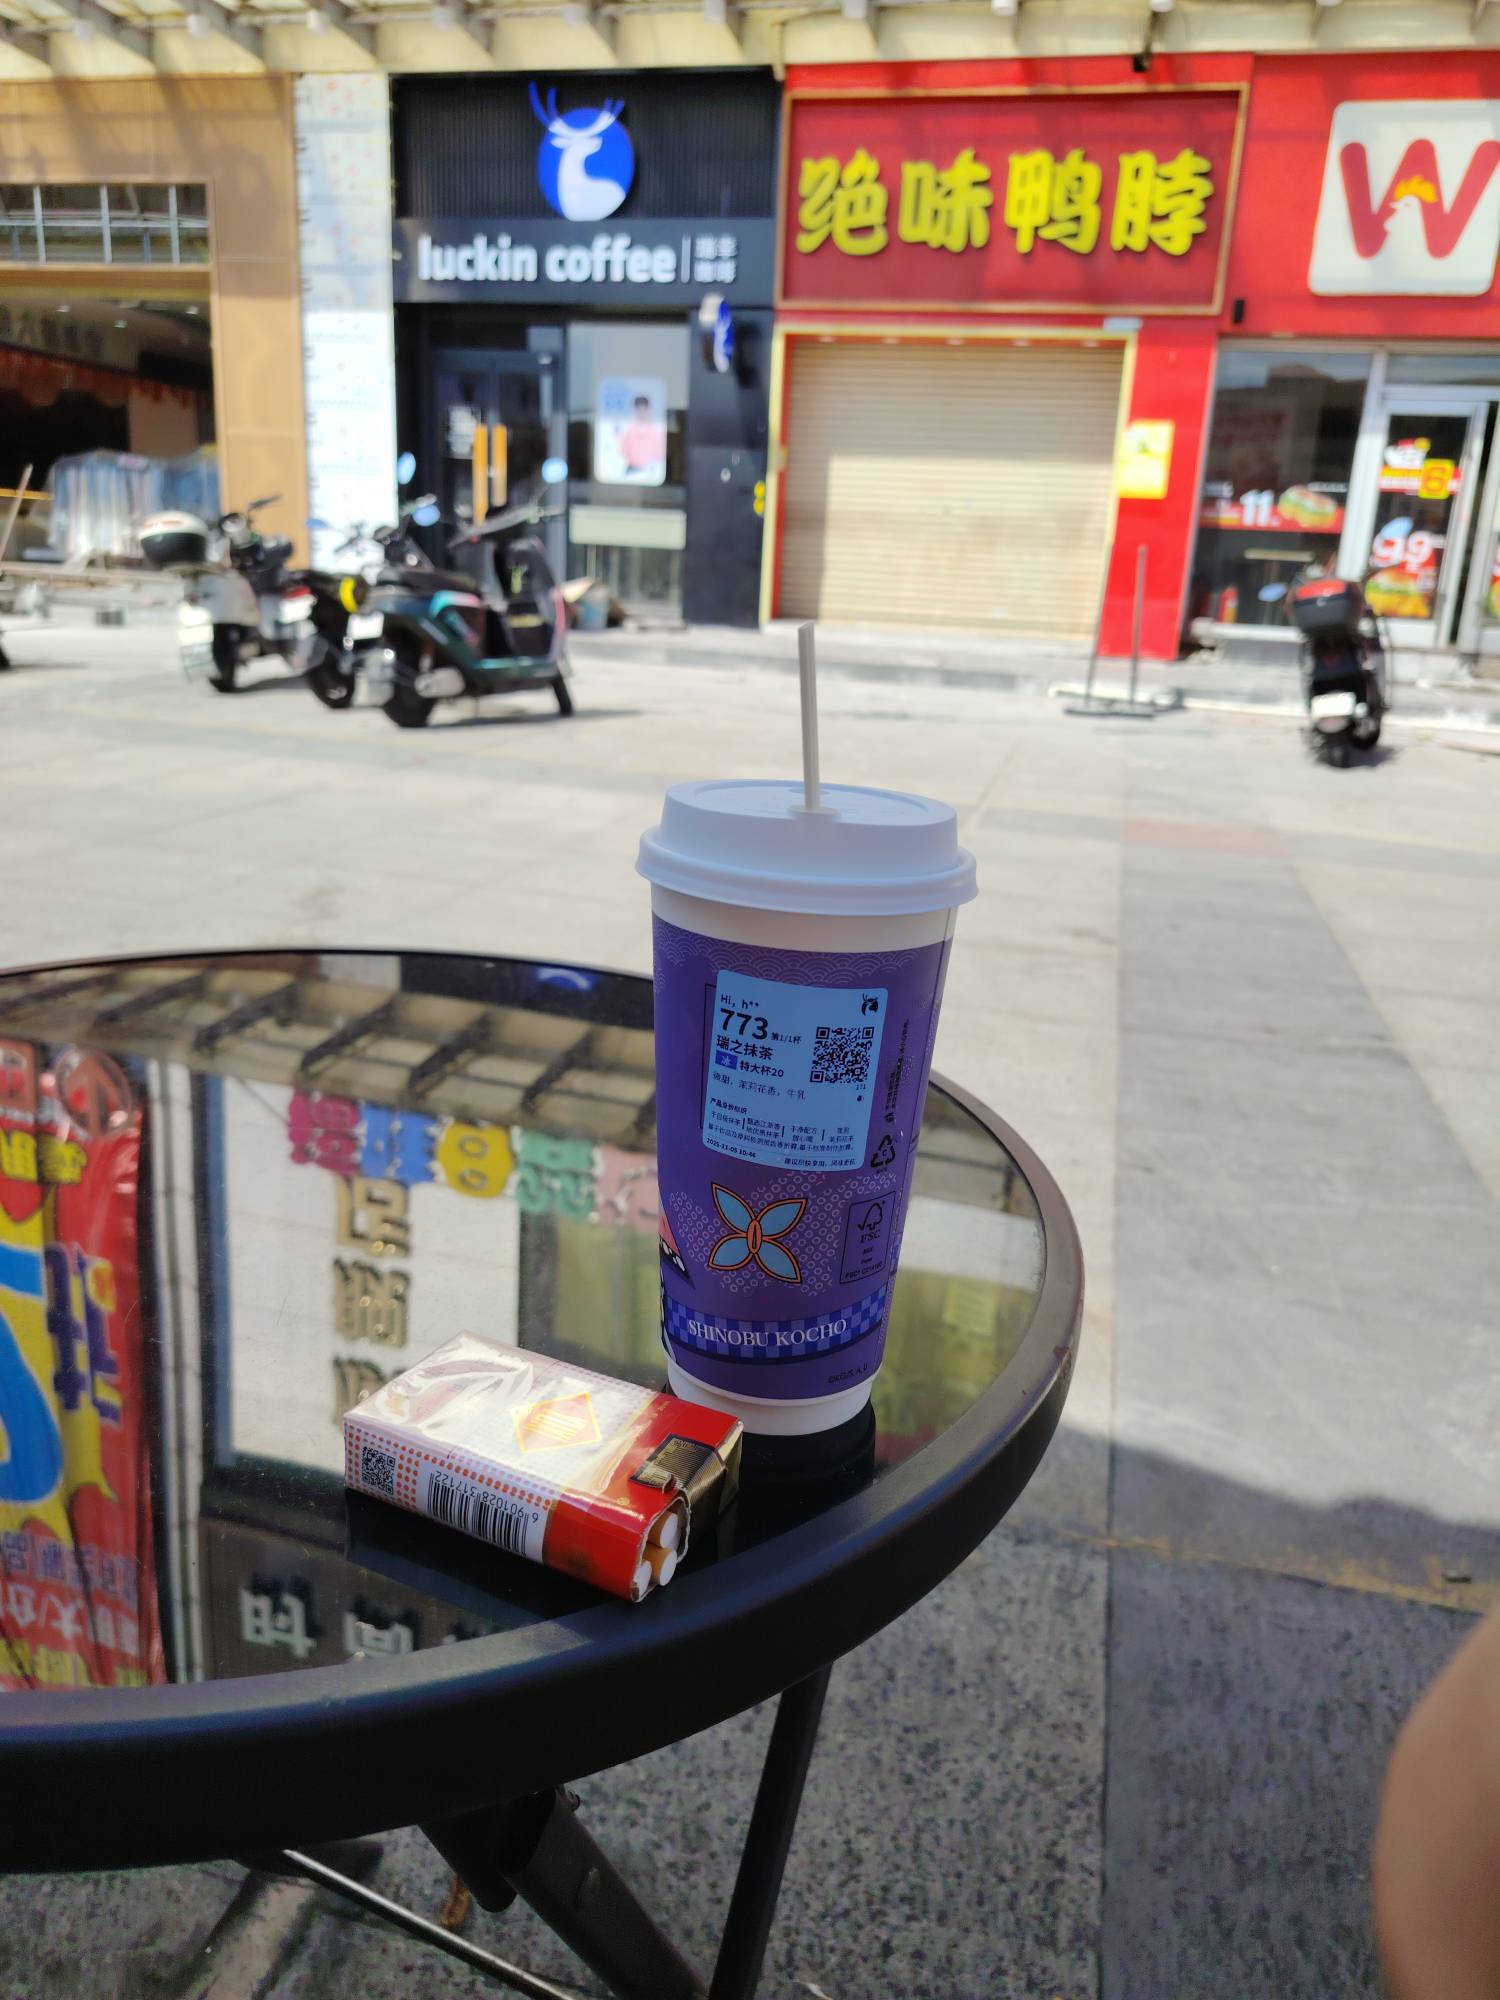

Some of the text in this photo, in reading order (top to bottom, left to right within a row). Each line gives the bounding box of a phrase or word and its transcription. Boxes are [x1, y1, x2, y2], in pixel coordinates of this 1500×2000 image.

[796, 147, 1214, 257] 绝味鸭脖
[417, 233, 677, 282] luckin coffee
[720, 1007, 768, 1040] 773
[716, 1035, 773, 1061] 瑞之抹茶
[740, 1060, 784, 1078] 特大杯20
[688, 1319, 847, 1347] SHINOBU KOCHO
[434, 1471, 539, 1524] 6 901028 317122
